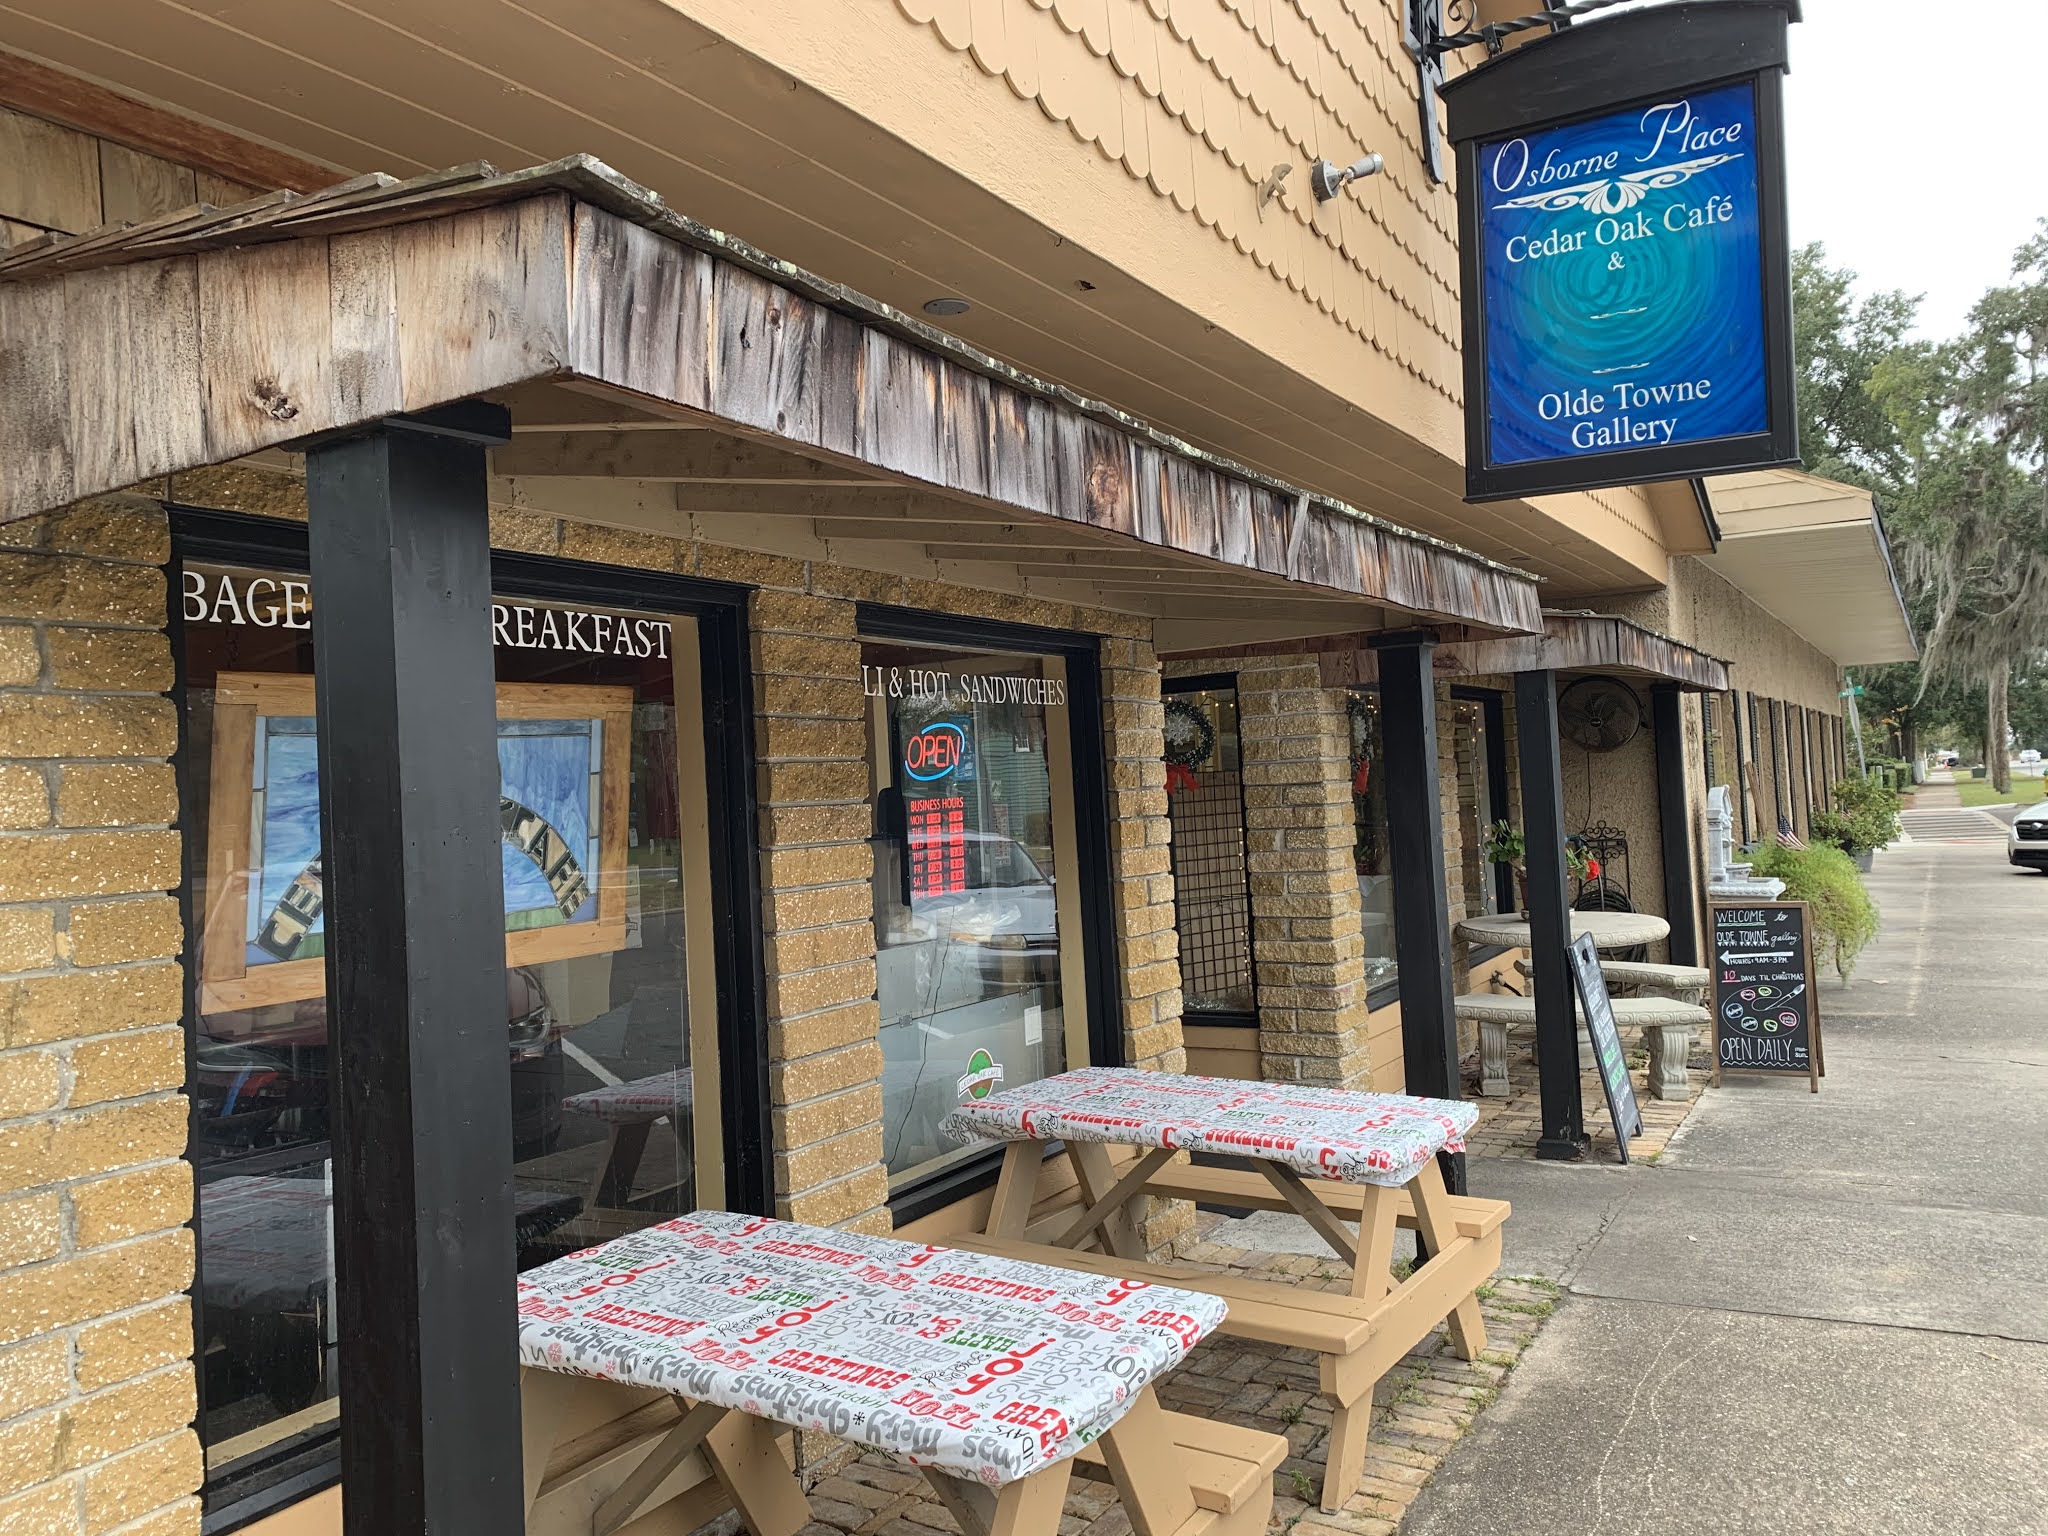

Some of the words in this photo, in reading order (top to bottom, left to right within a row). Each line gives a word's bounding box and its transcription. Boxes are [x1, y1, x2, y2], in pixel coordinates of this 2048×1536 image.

[1492, 138, 1618, 192] Osborne
[1635, 100, 1742, 163] Place
[1506, 230, 1586, 262] Cedar
[1595, 212, 1653, 245] Oak
[1663, 195, 1733, 232] Café
[1607, 252, 1625, 270] &
[1538, 391, 1604, 421] Olde
[1613, 379, 1712, 409] Towne
[1571, 417, 1677, 449] Gallery
[183, 571, 311, 629] BAGE
[492, 604, 671, 660] REAKFAST
[862, 665, 884, 697] LI
[889, 667, 903, 698] &
[909, 669, 950, 700] HOT
[960, 674, 1065, 705] SANDWICHES
[907, 735, 961, 768] OPEN
[910, 799, 941, 812] BUSINESS
[942, 797, 964, 809] HOURS
[910, 815, 923, 825] MON
[912, 827, 923, 837] TUE
[912, 852, 923, 862] THU
[913, 864, 922, 874] FRI
[913, 877, 923, 887] SAT
[913, 889, 924, 899] SUN
[1716, 910, 1765, 922] WELCOME
[1774, 911, 1788, 921] to
[1717, 931, 1735, 941] OLDE
[1739, 930, 1768, 942] TOWNE
[1724, 970, 1736, 980] 10
[1772, 973, 1804, 981] CHRISTMAS
[1720, 1037, 1752, 1060] OPEN
[1757, 1039, 1792, 1061] DAILY
[752, 1240, 867, 1266] GREETINGS
[849, 1264, 919, 1291] NOEL
[928, 1272, 1057, 1302] GREETINGS
[583, 1303, 708, 1336] GREETINGS
[1044, 1301, 1126, 1332] NOEL
[941, 1329, 1019, 1352] HAPPY
[681, 1338, 757, 1371] NOEL
[764, 1368, 838, 1392] HOLIDAYS
[768, 1349, 912, 1390] GREETINGS
[890, 1389, 981, 1430] NOEL
